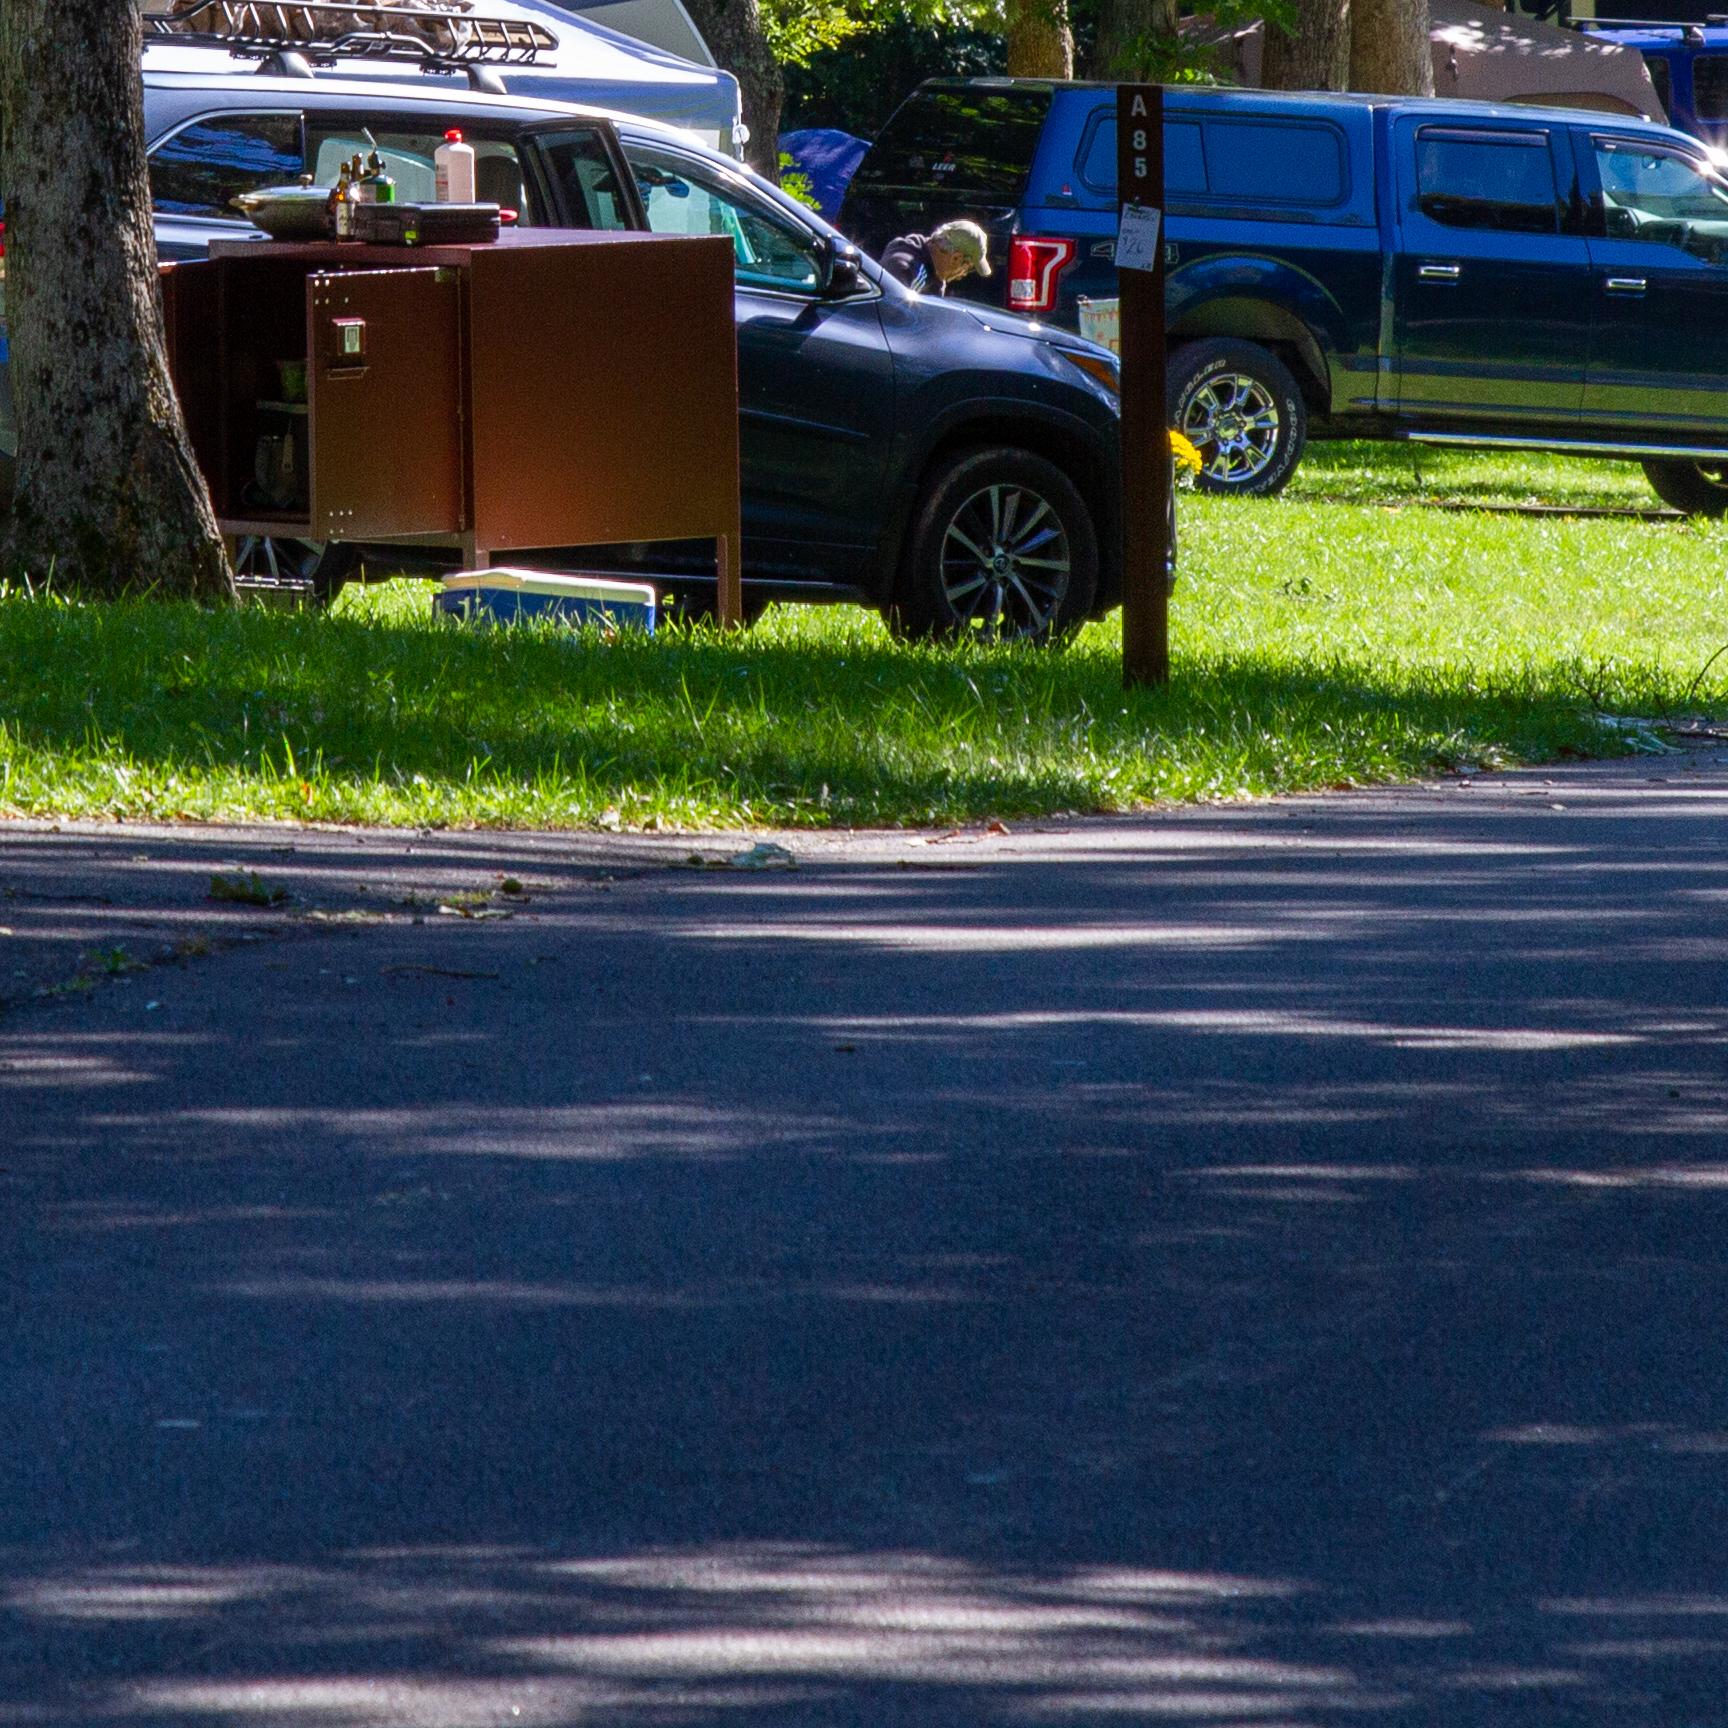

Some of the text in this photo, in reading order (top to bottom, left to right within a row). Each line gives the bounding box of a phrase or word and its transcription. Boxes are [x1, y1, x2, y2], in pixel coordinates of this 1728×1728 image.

[932, 162, 956, 172] LEER
[1131, 94, 1148, 178] A 85
[1174, 358, 1226, 424] ANGLER
